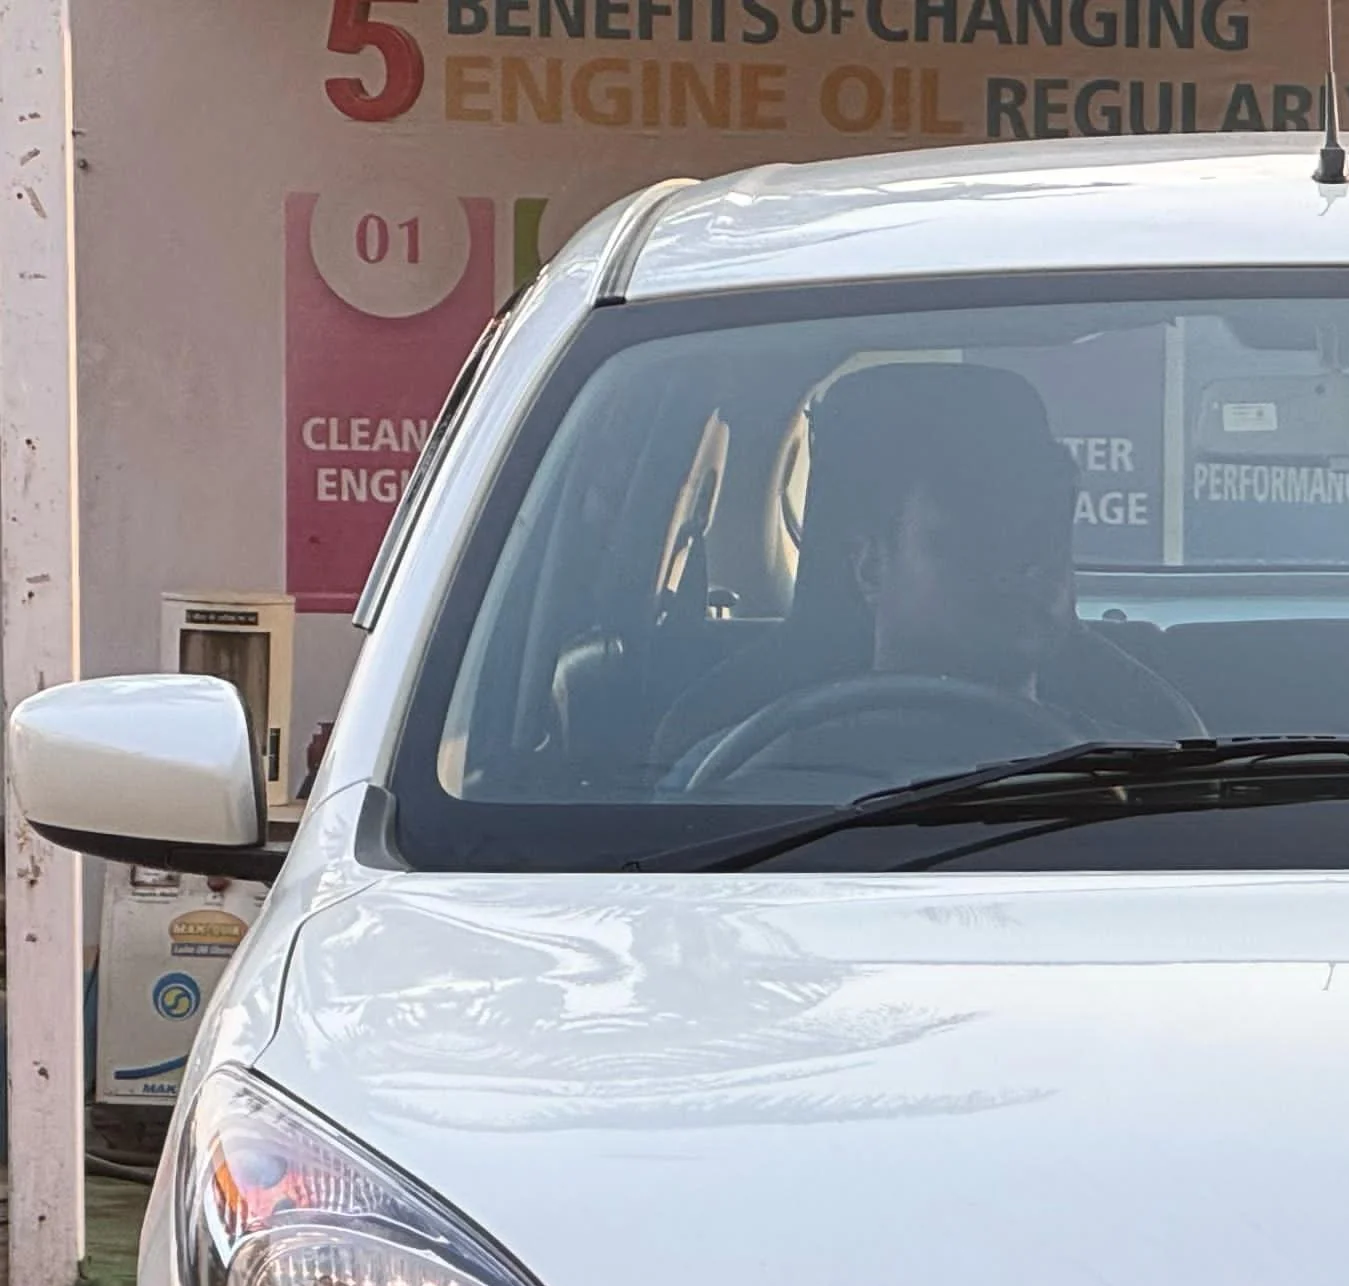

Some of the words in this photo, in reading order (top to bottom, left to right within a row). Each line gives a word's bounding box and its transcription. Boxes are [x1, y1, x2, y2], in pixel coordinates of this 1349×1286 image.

[324, 0, 425, 122] 5
[446, 0, 779, 45] BENEFITS
[792, 0, 856, 35] OF
[866, 0, 1250, 51] CHANGING
[444, 55, 788, 131] ENGINE
[820, 64, 964, 136] OIL
[355, 212, 420, 265] 01
